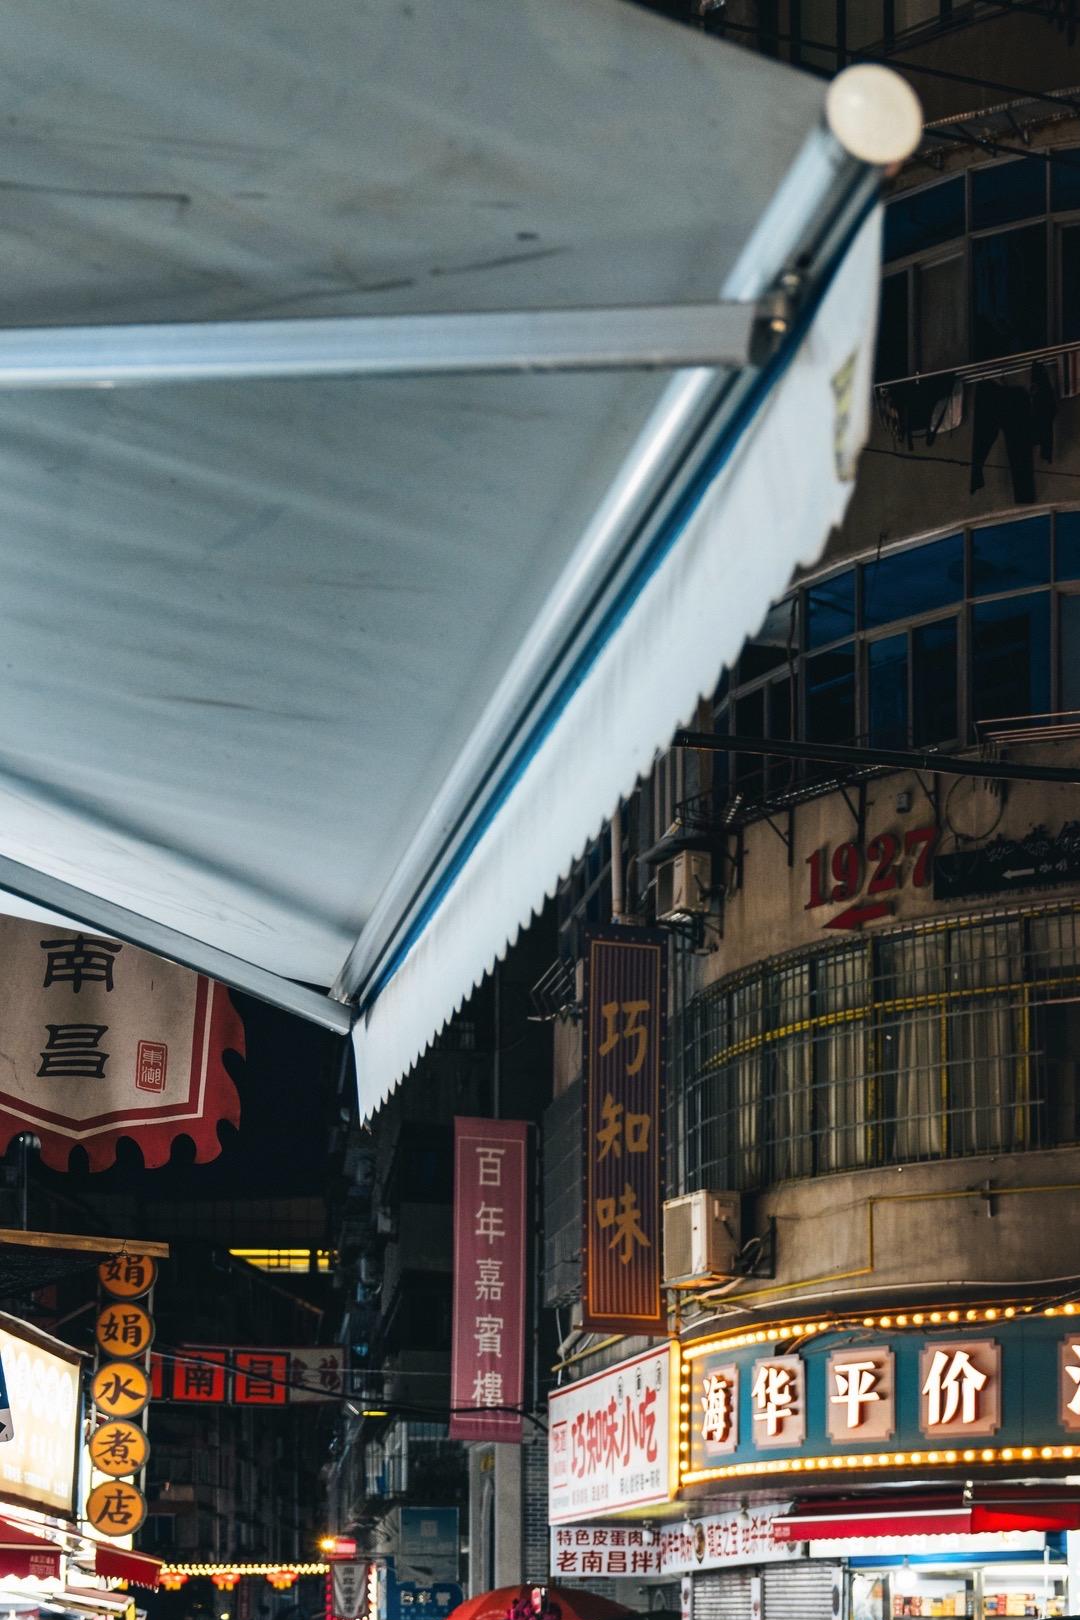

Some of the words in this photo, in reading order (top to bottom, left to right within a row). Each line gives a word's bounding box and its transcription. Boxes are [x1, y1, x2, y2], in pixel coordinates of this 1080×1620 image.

[804, 827, 938, 910] 1927
[36, 933, 124, 1079] 南昌
[596, 1000, 653, 1266] 巧知味
[471, 1147, 506, 1411] 百年嘉賓樓
[570, 1386, 658, 1479] 巧知味小吃
[701, 1349, 988, 1442] 海华平价
